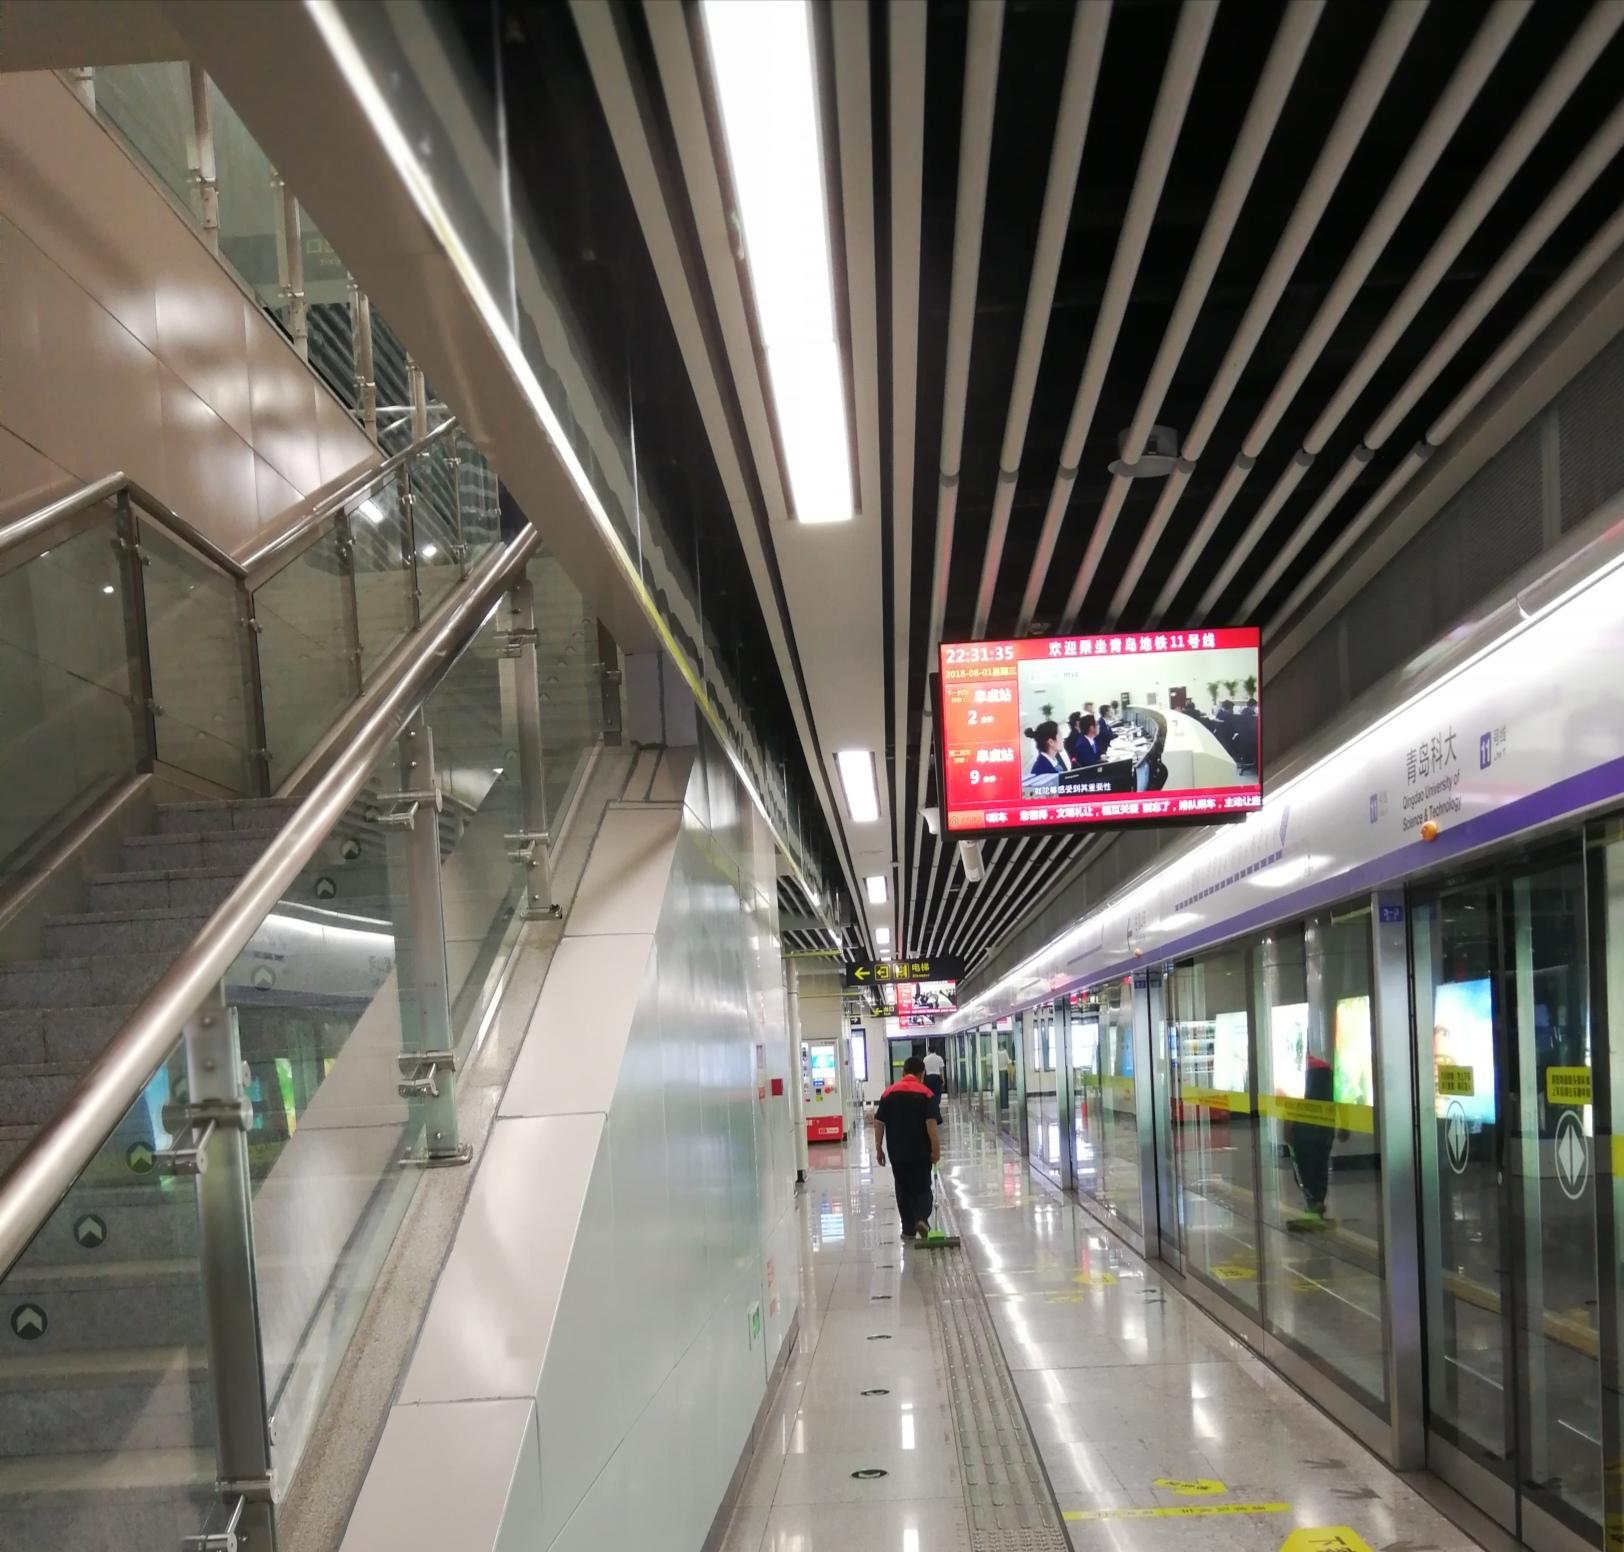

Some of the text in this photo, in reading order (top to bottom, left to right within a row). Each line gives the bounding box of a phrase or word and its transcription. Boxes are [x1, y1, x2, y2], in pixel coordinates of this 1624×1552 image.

[945, 646, 1014, 663] 22:31:35
[1049, 633, 1215, 656] 欢迎乘坐青岛地铁11号线
[967, 710, 978, 725] 2
[1406, 725, 1456, 785] 青岛科大
[969, 770, 980, 784] 9
[1402, 790, 1424, 811] Qingdao
[1425, 774, 1453, 800] University
[1453, 769, 1460, 785] of
[1403, 813, 1423, 831] Science
[1429, 793, 1461, 818] Technology
